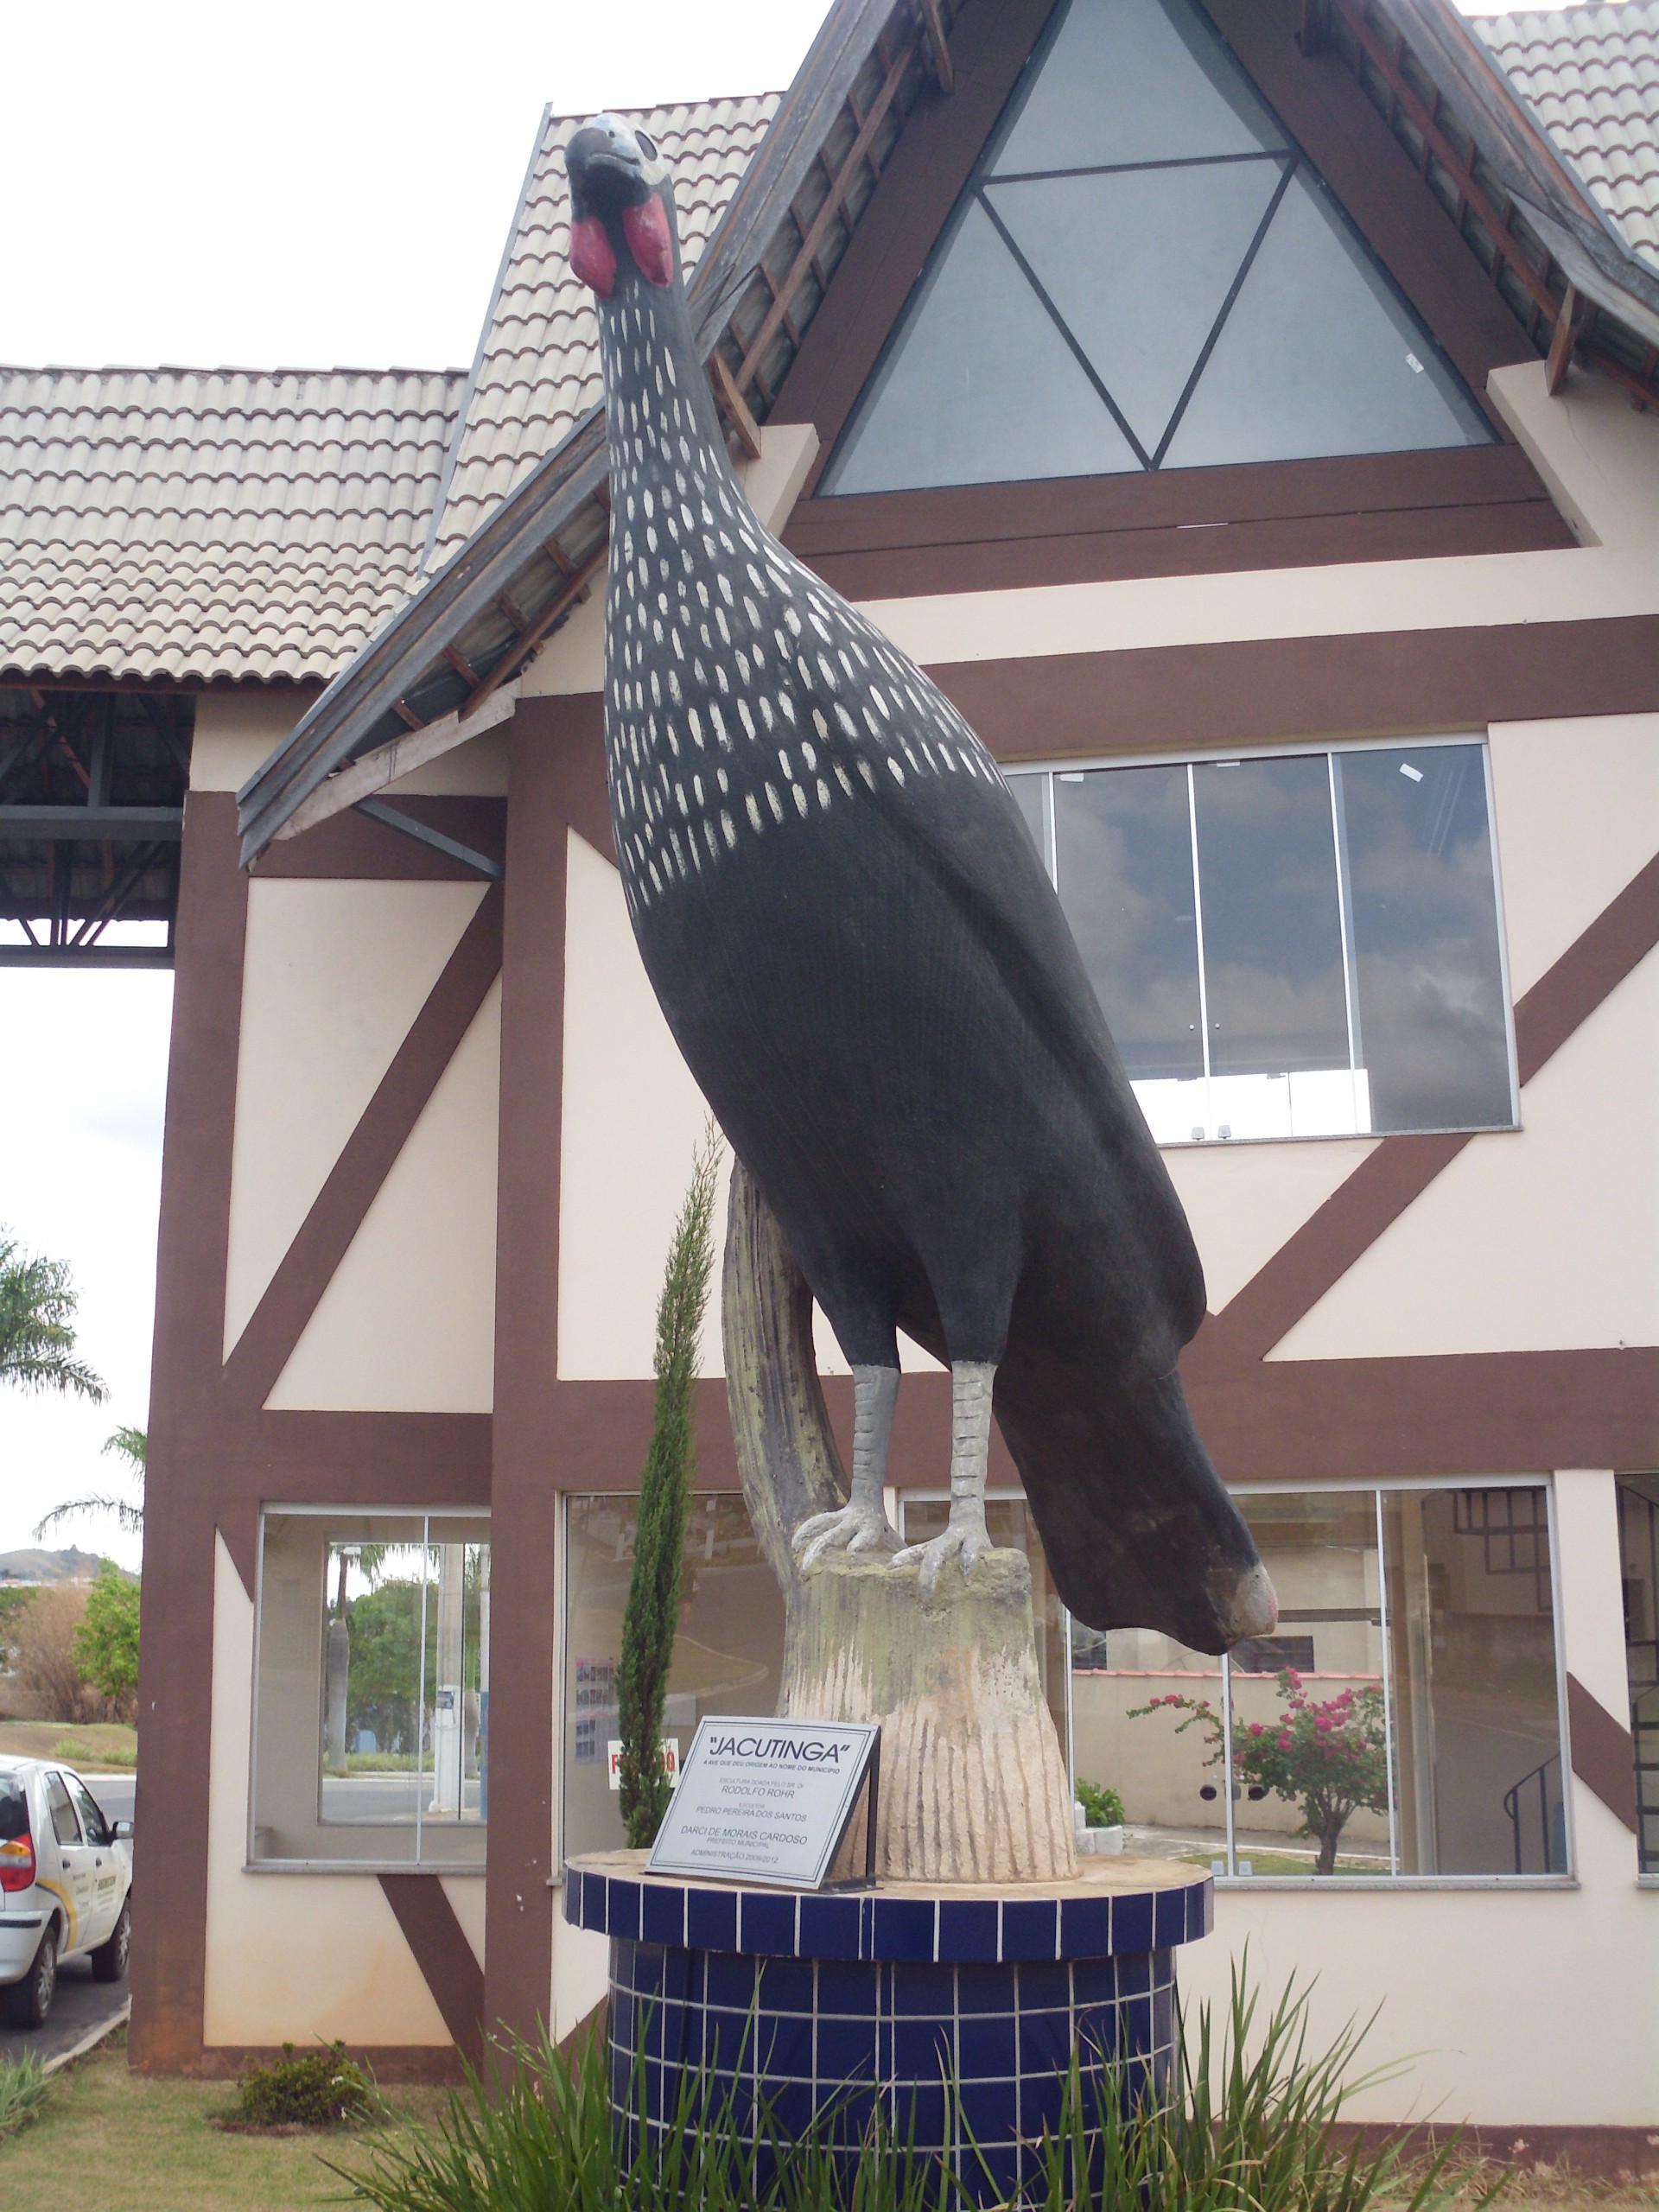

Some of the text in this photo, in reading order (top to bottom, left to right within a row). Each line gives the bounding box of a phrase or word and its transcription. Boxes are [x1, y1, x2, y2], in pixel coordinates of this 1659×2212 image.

[808, 1765, 840, 1775] MUNICÍPIO
[721, 1785, 795, 1798] RODOLFO ROHR
[696, 1806, 807, 1822] PEDRO PEREIRA DOS SANTOS
[681, 1825, 808, 1845] DARCI DE MORAIS CARDOSO
[706, 1837, 769, 1849] PREFEITO MUNICIPAL
[691, 1849, 744, 1860] ADMINISTRAÇÃO
